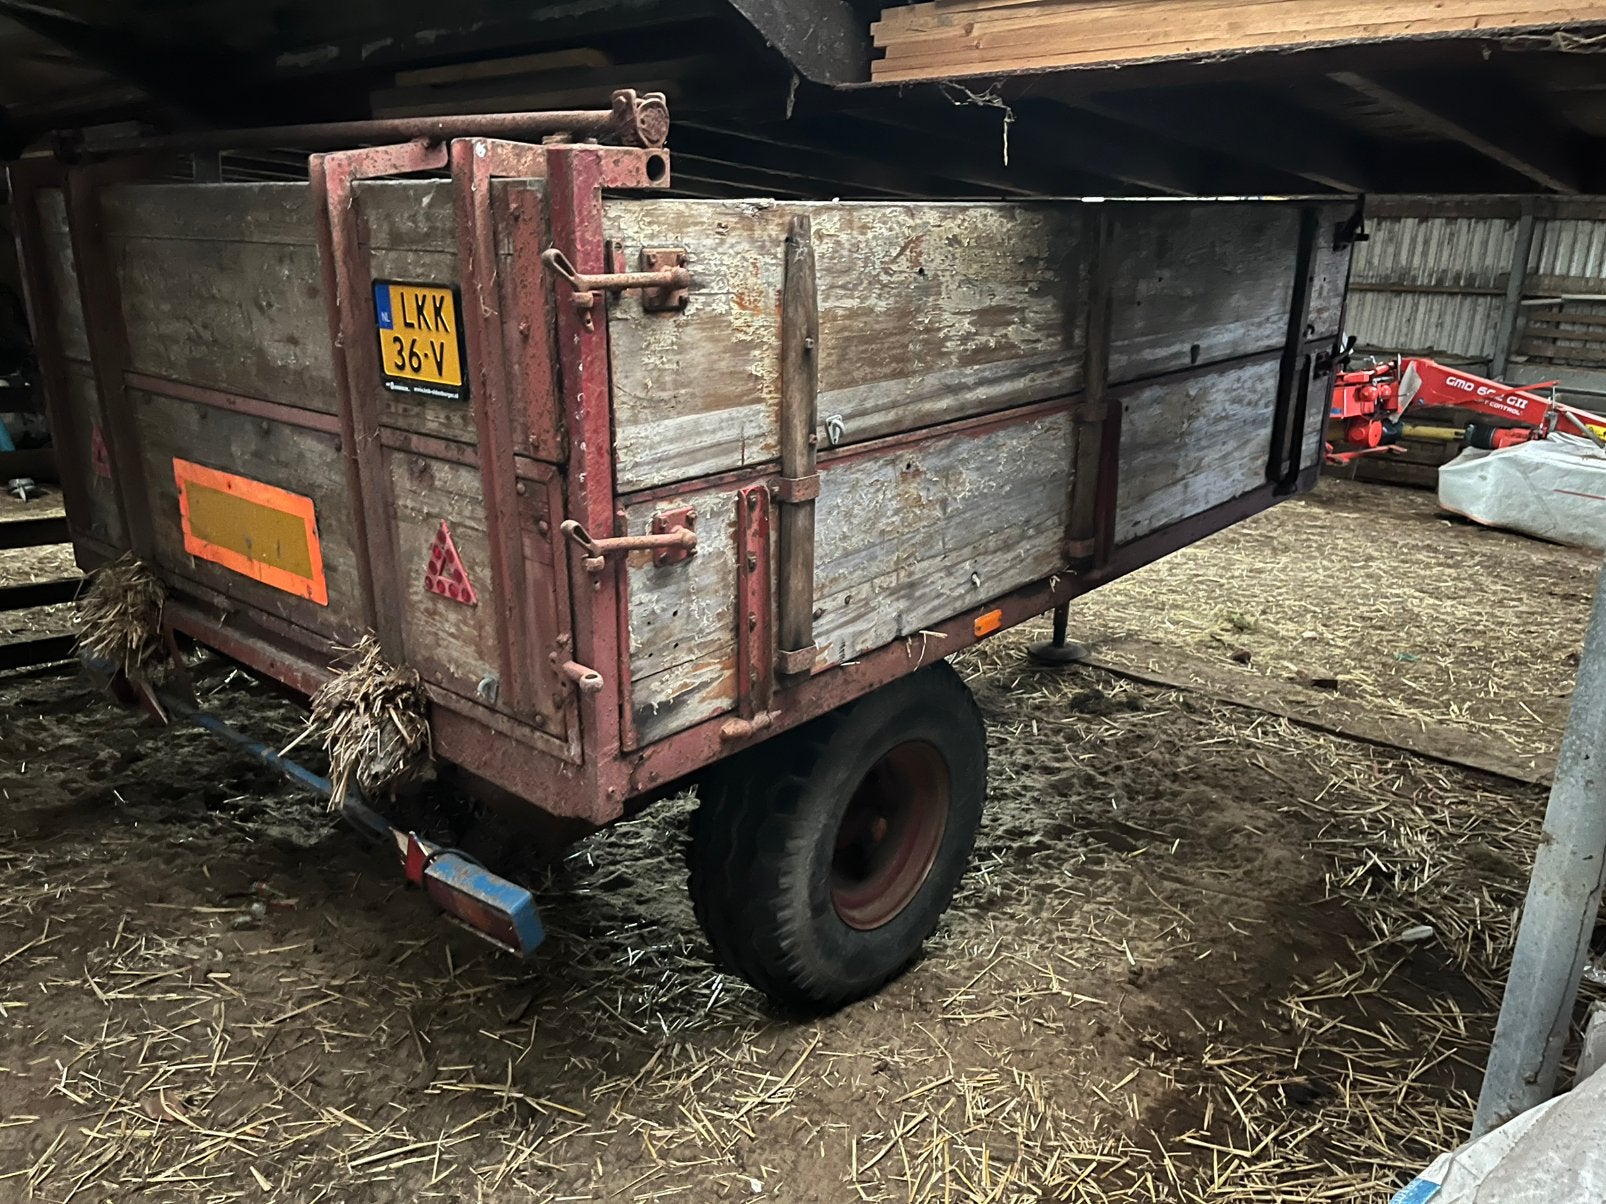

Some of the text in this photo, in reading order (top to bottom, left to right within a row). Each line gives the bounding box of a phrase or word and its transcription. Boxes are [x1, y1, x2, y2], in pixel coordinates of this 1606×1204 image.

[381, 311, 391, 322] NL
[400, 291, 450, 333] LKK
[1446, 376, 1474, 391] GMD
[1489, 401, 1520, 415] CONTROL
